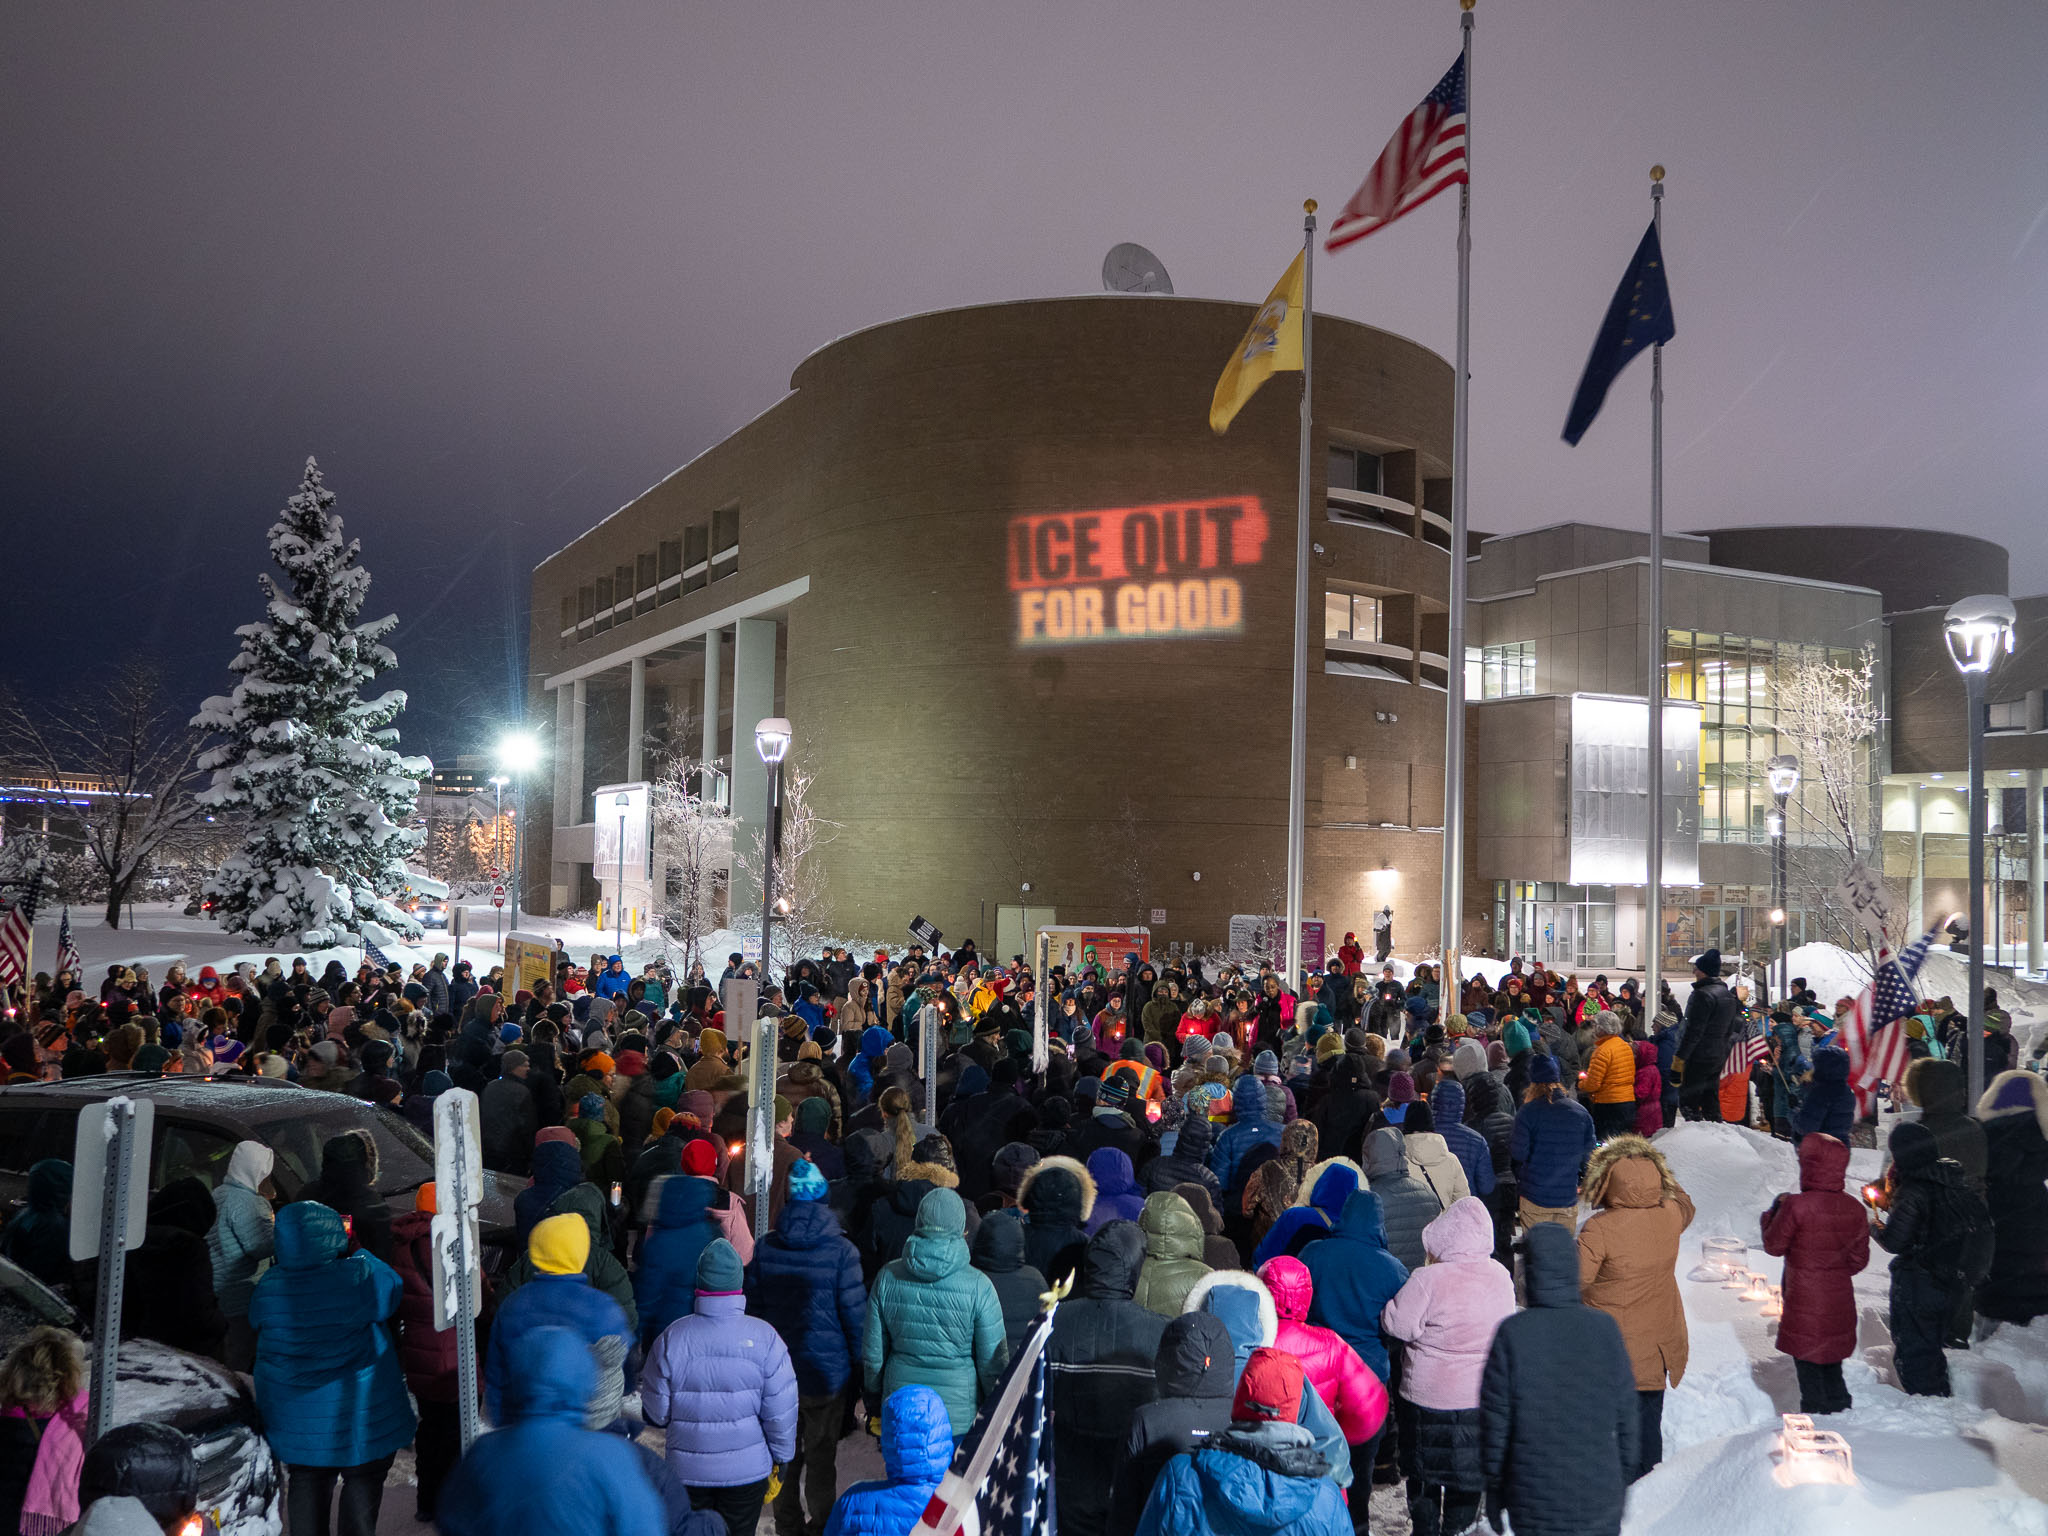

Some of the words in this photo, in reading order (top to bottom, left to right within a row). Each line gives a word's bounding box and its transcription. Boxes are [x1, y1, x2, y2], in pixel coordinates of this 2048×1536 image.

[1016, 516, 1103, 581] ICE
[1121, 505, 1244, 576] OUT
[1020, 587, 1105, 639] FOR
[1116, 577, 1243, 634] GOOD
